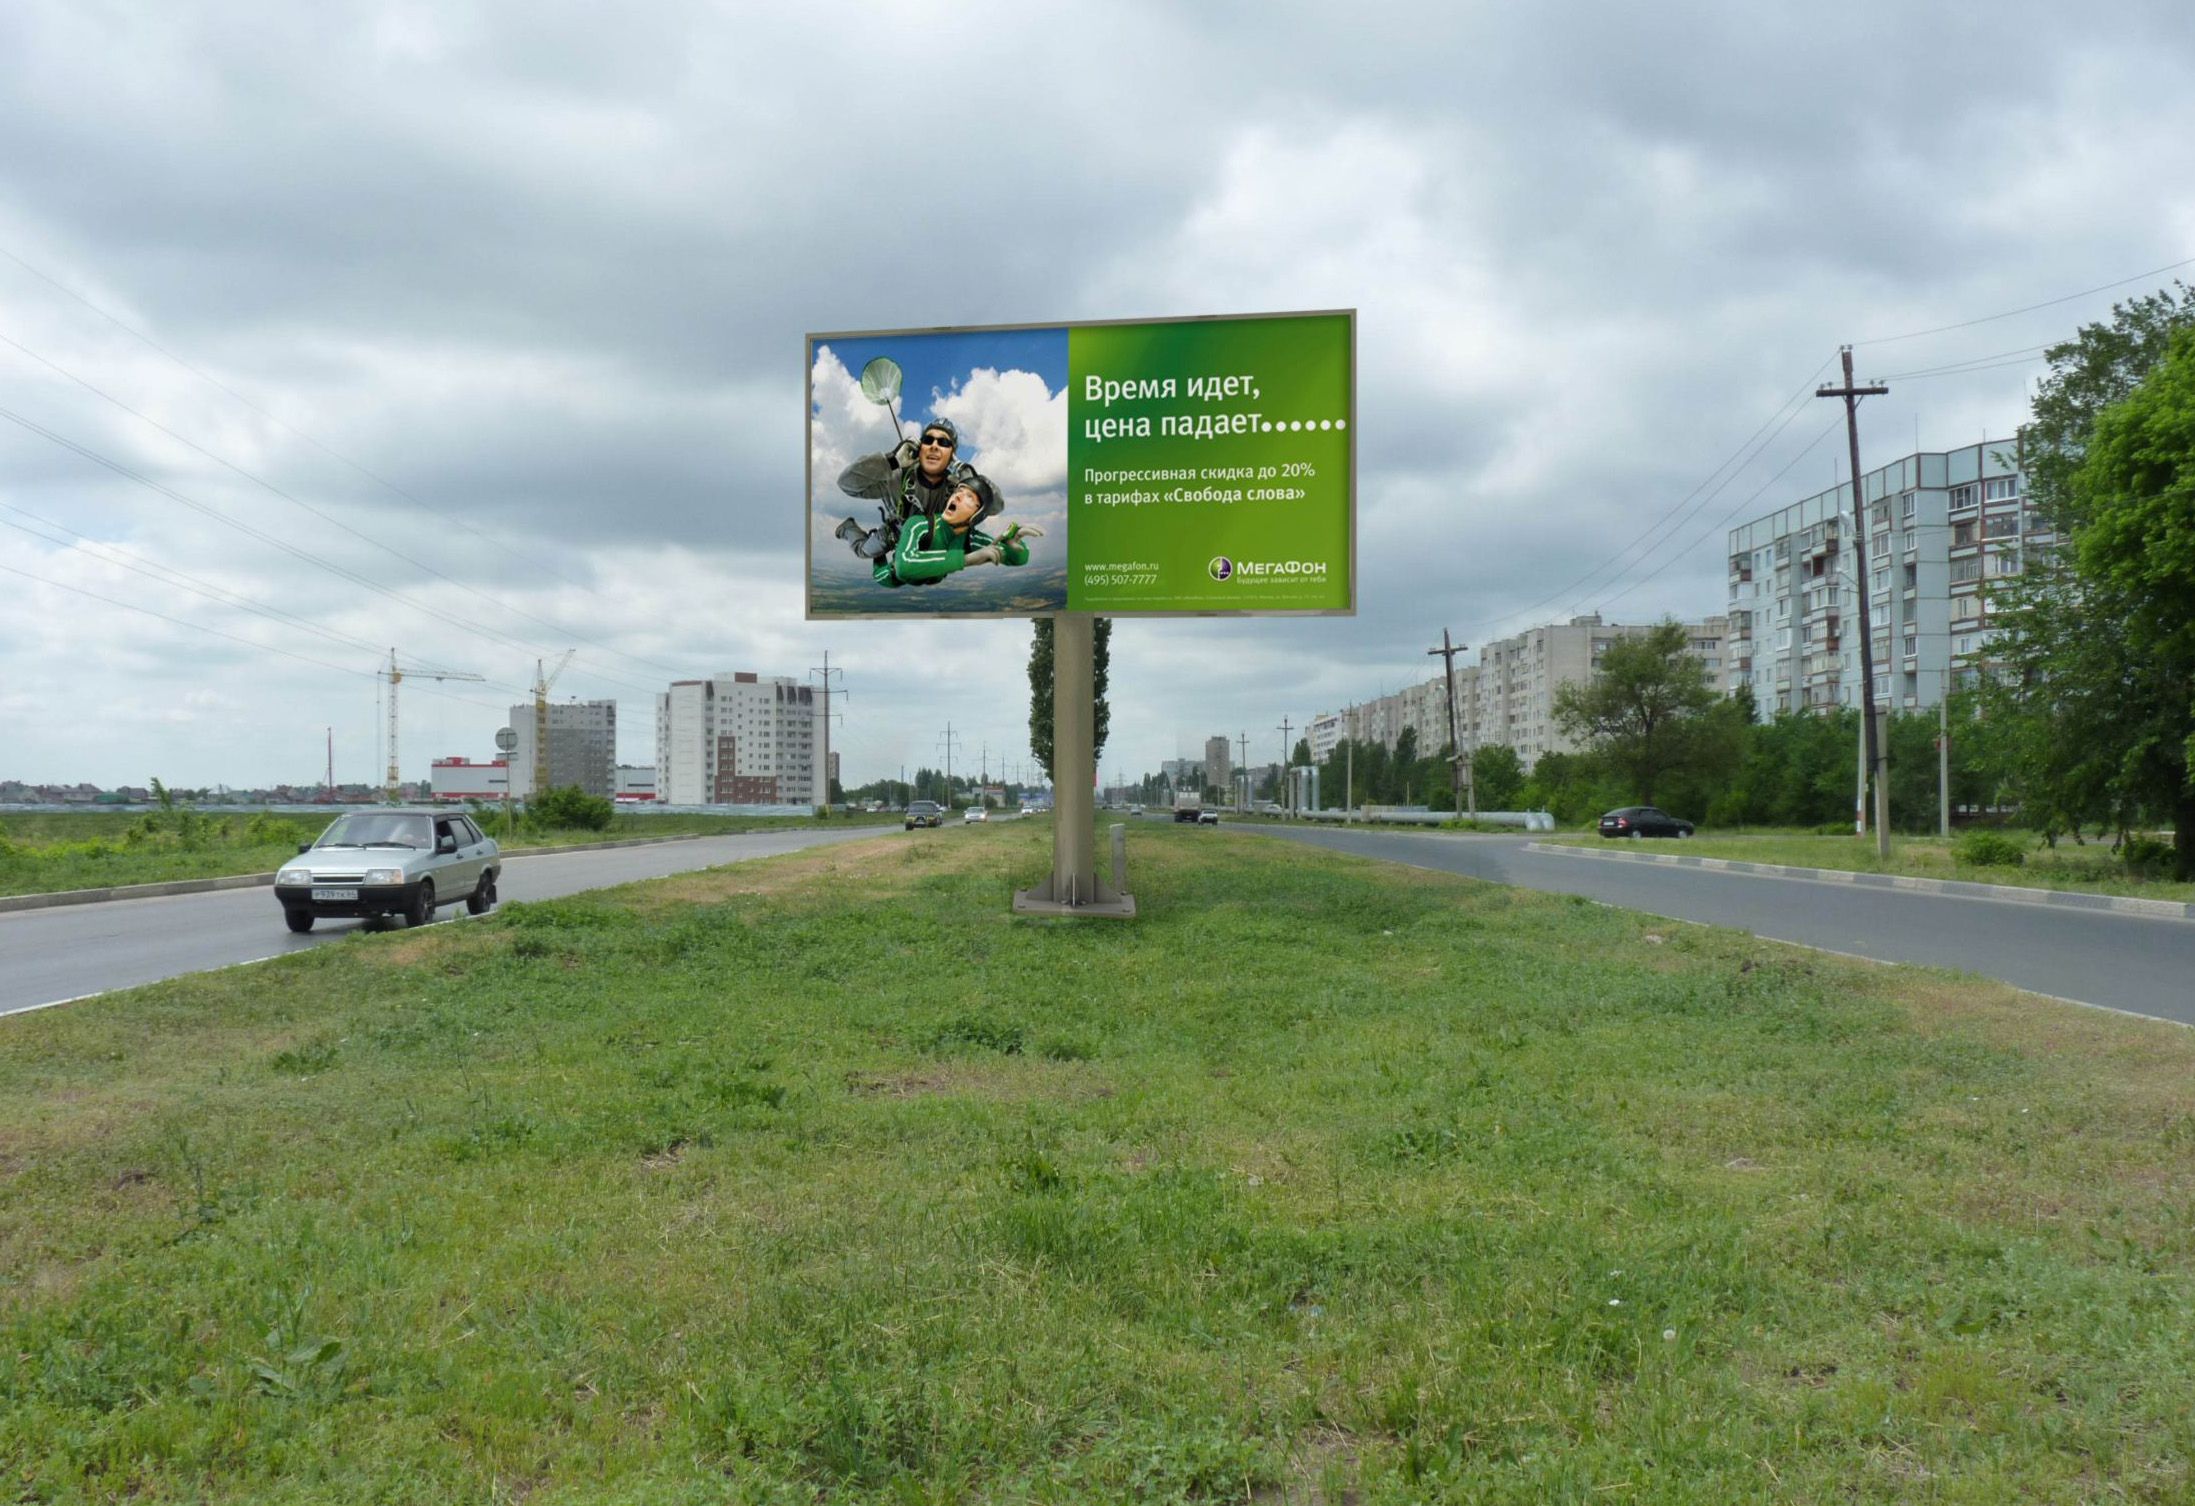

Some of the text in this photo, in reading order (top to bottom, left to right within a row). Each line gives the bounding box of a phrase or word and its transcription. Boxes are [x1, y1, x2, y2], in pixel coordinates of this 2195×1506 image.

[1085, 375, 1260, 407] Время идет,
[1085, 416, 1151, 442] цена
[1085, 462, 1315, 485] Прогрессивная скидка до 20%
[1085, 486, 1305, 507] в тарифах «Свобода слова»
[1084, 561, 1159, 572] www.megafon.ru
[1084, 574, 1157, 586] (495) 507-7777
